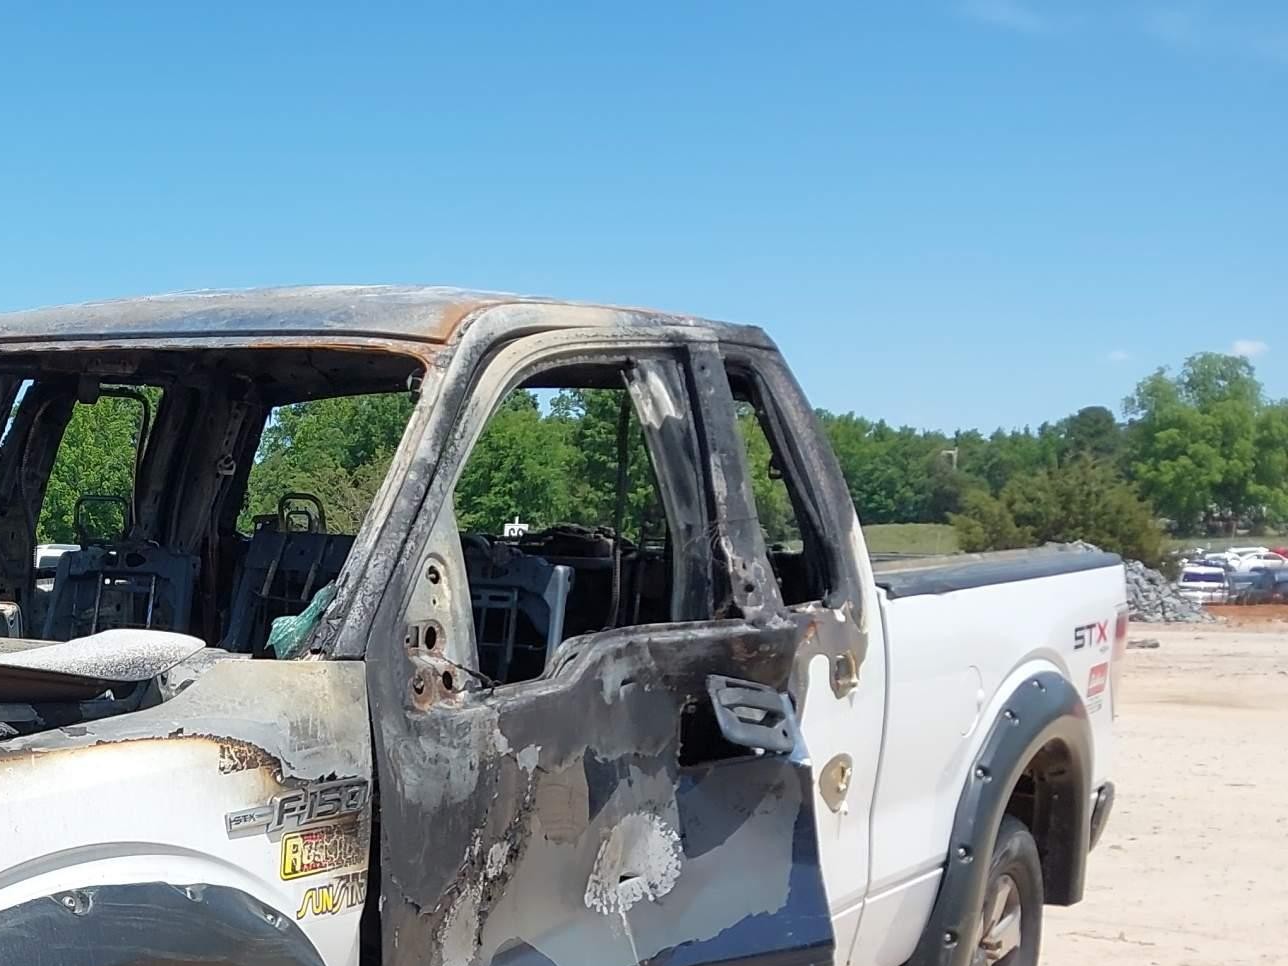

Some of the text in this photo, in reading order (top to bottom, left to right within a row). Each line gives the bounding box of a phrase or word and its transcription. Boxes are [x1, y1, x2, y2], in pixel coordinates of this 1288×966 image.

[1073, 619, 1109, 650] STX
[231, 812, 257, 826] STX
[272, 786, 366, 832] F-150
